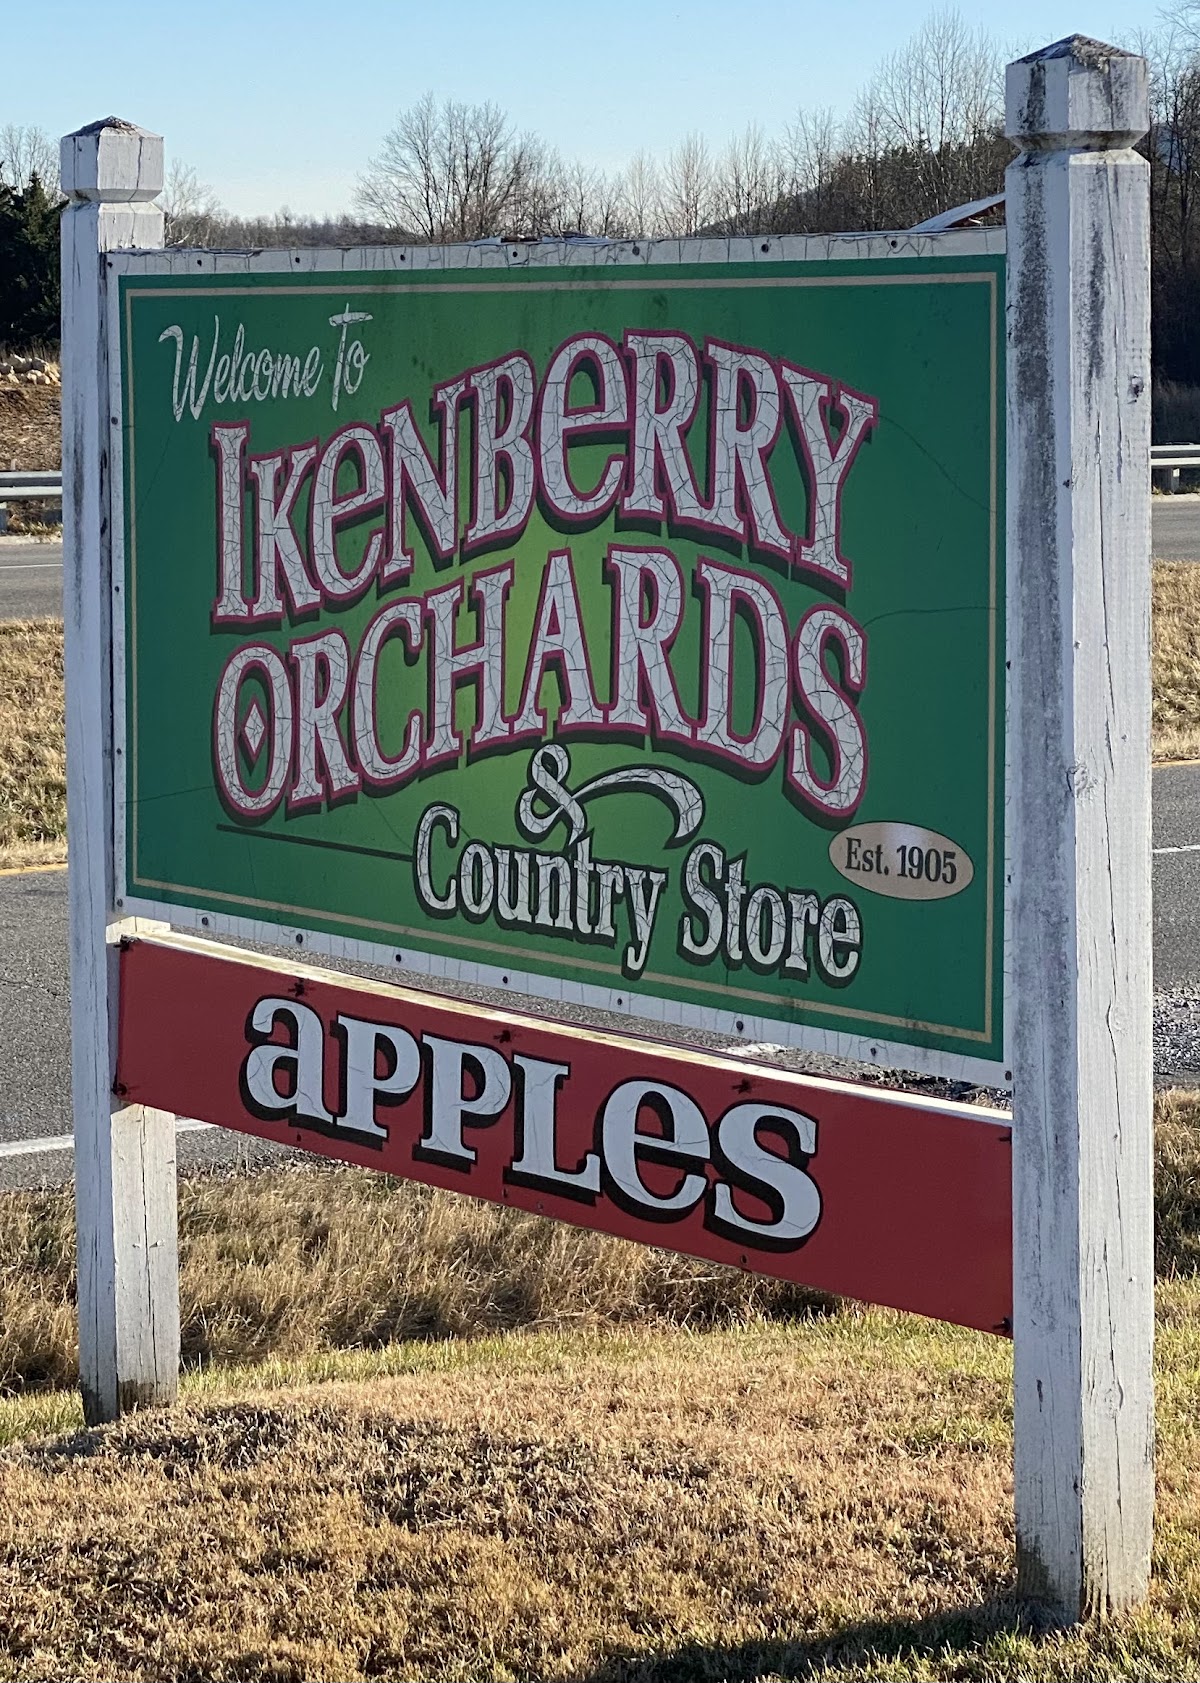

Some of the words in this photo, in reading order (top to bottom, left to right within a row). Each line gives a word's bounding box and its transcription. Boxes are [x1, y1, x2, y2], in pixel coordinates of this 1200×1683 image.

[158, 314, 324, 422] Welcome
[328, 302, 374, 412] To
[212, 543, 870, 826] ORCHARDS
[516, 742, 705, 849] &
[414, 803, 667, 980] Country
[678, 839, 864, 986] Store
[845, 837, 889, 876] Est.
[896, 845, 957, 884] 1905
